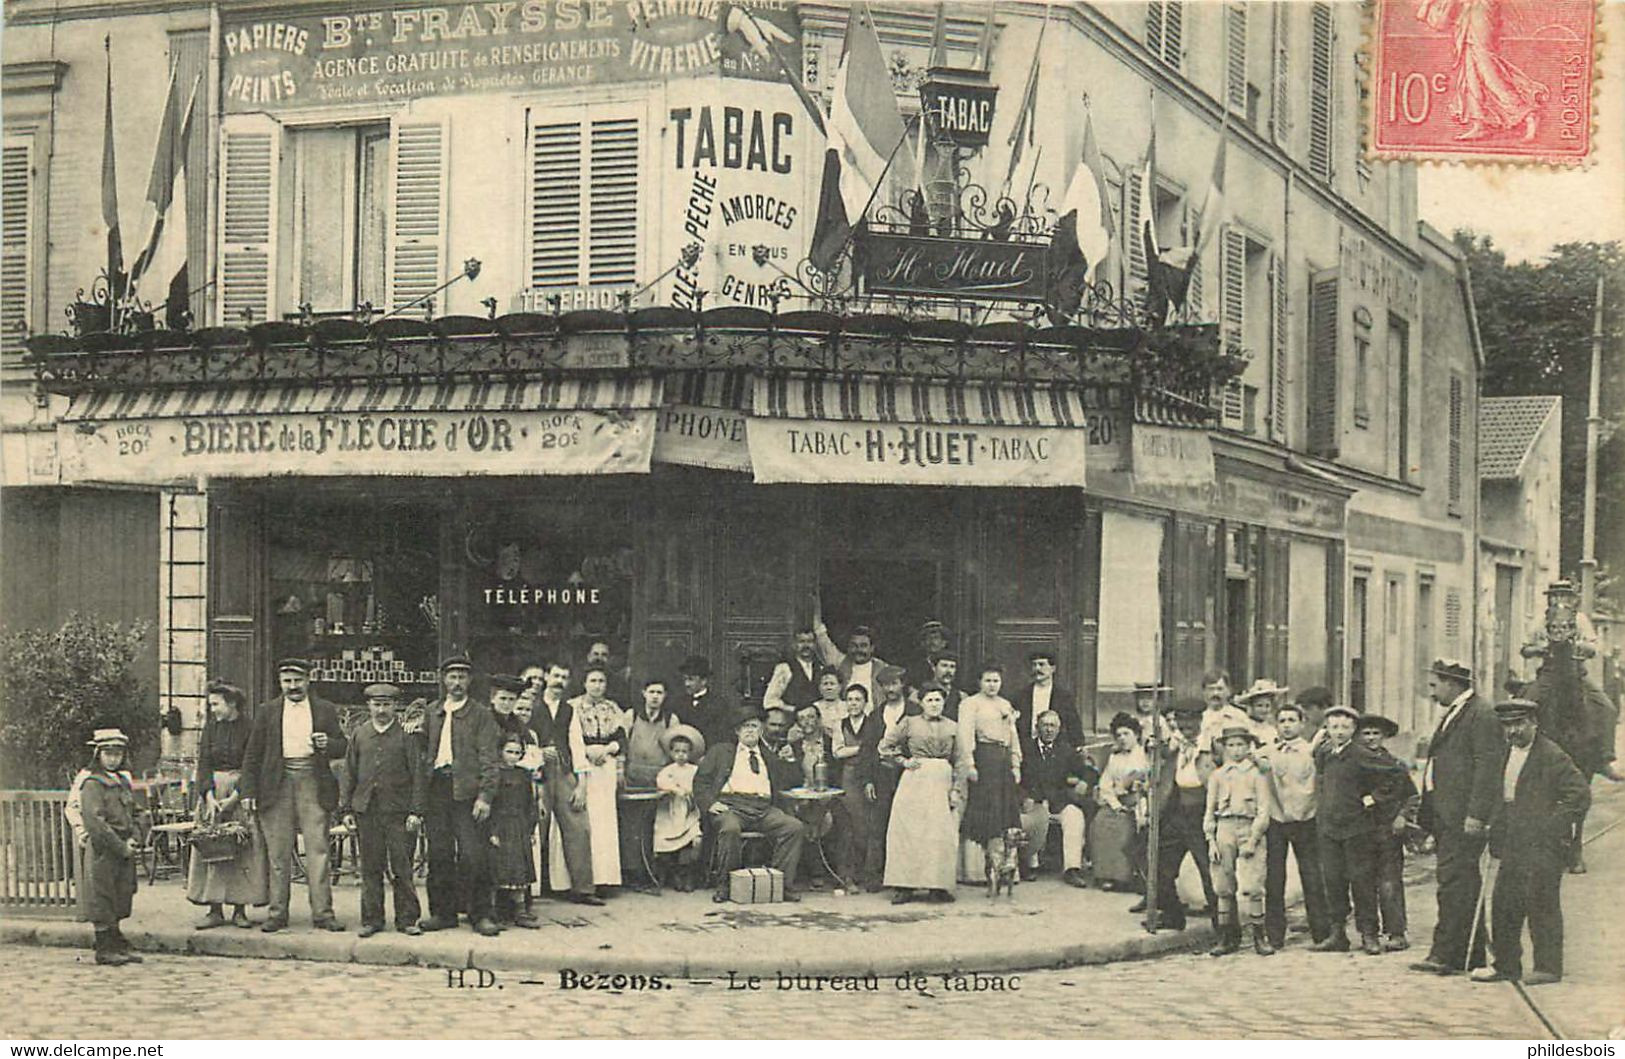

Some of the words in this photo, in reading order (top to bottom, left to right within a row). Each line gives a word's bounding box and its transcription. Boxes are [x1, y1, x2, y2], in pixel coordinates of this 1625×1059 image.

[224, 23, 309, 56] PAPIERS
[392, 0, 613, 43] FRAYSSE
[312, 56, 379, 79] AGENCE
[386, 48, 469, 73] GRATUITE
[473, 51, 488, 67] de
[491, 38, 621, 65] RENSEIGNEMENTS
[629, 32, 721, 73] VITRERIE
[228, 70, 296, 103] PEINTS
[356, 84, 369, 97] et
[374, 79, 436, 97] Location
[1560, 52, 1583, 141] POSTES
[938, 96, 990, 133] TABAC
[670, 106, 793, 174] TABAC
[720, 194, 798, 230] AMORCES
[729, 244, 747, 257] EN
[935, 246, 1034, 291] Huet
[116, 424, 152, 439] BOCK
[279, 423, 295, 451] de
[298, 423, 314, 451] la
[445, 415, 513, 452] d'OR
[541, 415, 582, 431] BOCK
[787, 430, 850, 456] TABAC
[866, 429, 885, 462] H
[898, 427, 978, 467] HUET
[990, 437, 1049, 463] TABAC
[484, 584, 600, 604] TÉLÉPHONE
